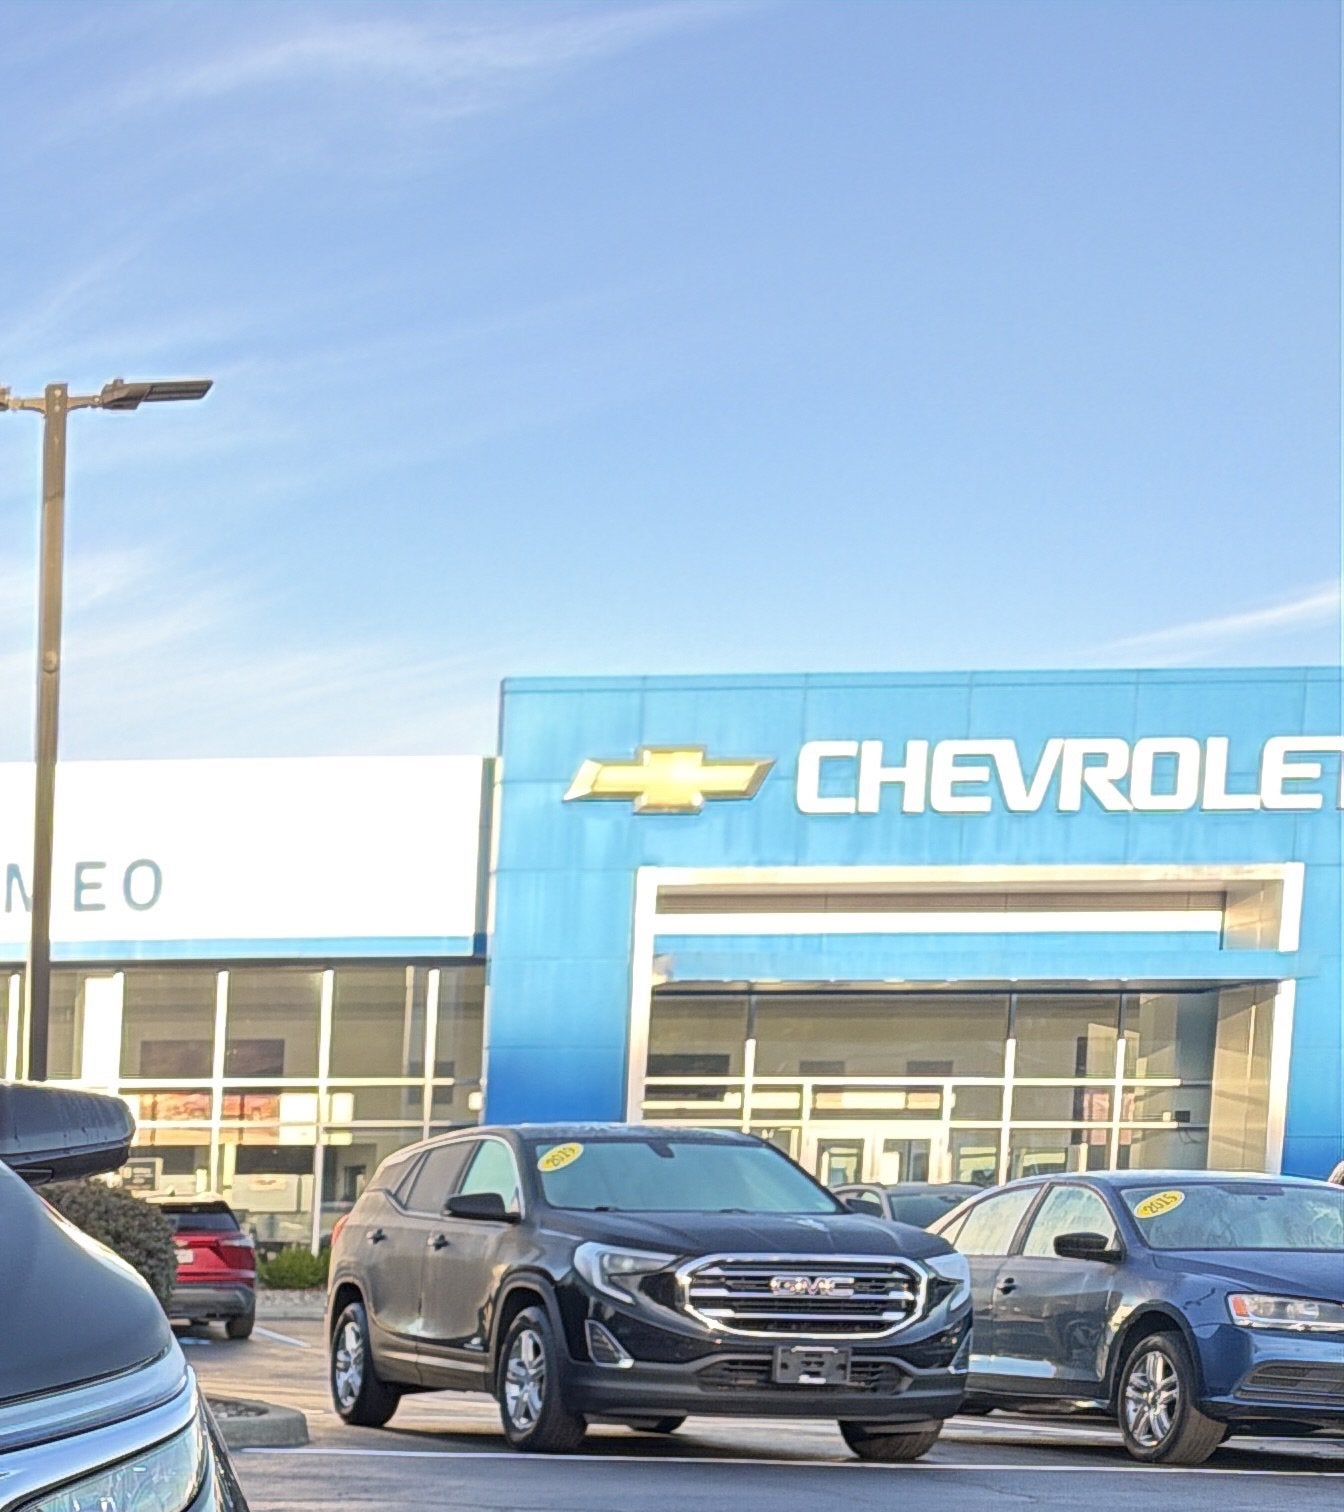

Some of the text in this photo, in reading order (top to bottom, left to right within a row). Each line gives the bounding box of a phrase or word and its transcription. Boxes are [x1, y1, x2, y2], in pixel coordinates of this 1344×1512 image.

[796, 735, 1344, 814] CHEVROLE
[1142, 1193, 1178, 1214] 2015
[770, 1276, 855, 1297] GMC
